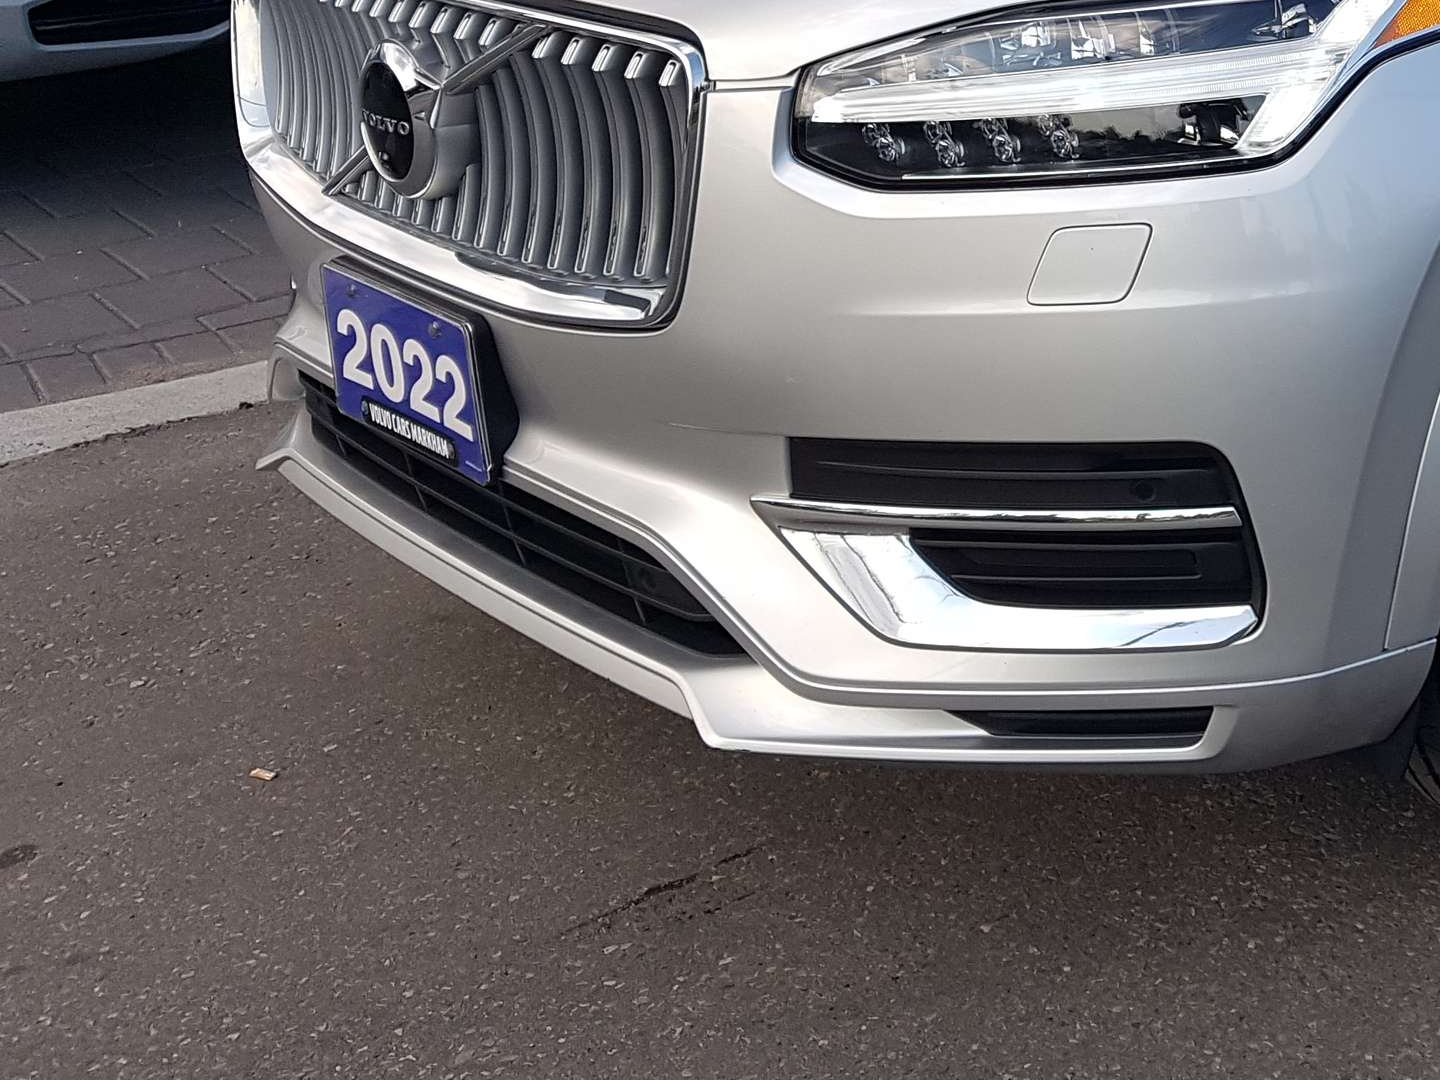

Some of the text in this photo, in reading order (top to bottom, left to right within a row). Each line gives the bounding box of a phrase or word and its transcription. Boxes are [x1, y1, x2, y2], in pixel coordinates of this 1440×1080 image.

[361, 108, 411, 136] VOLVO
[336, 308, 474, 443] 2022
[369, 402, 450, 460] VOLVO CARS MARKHAM
